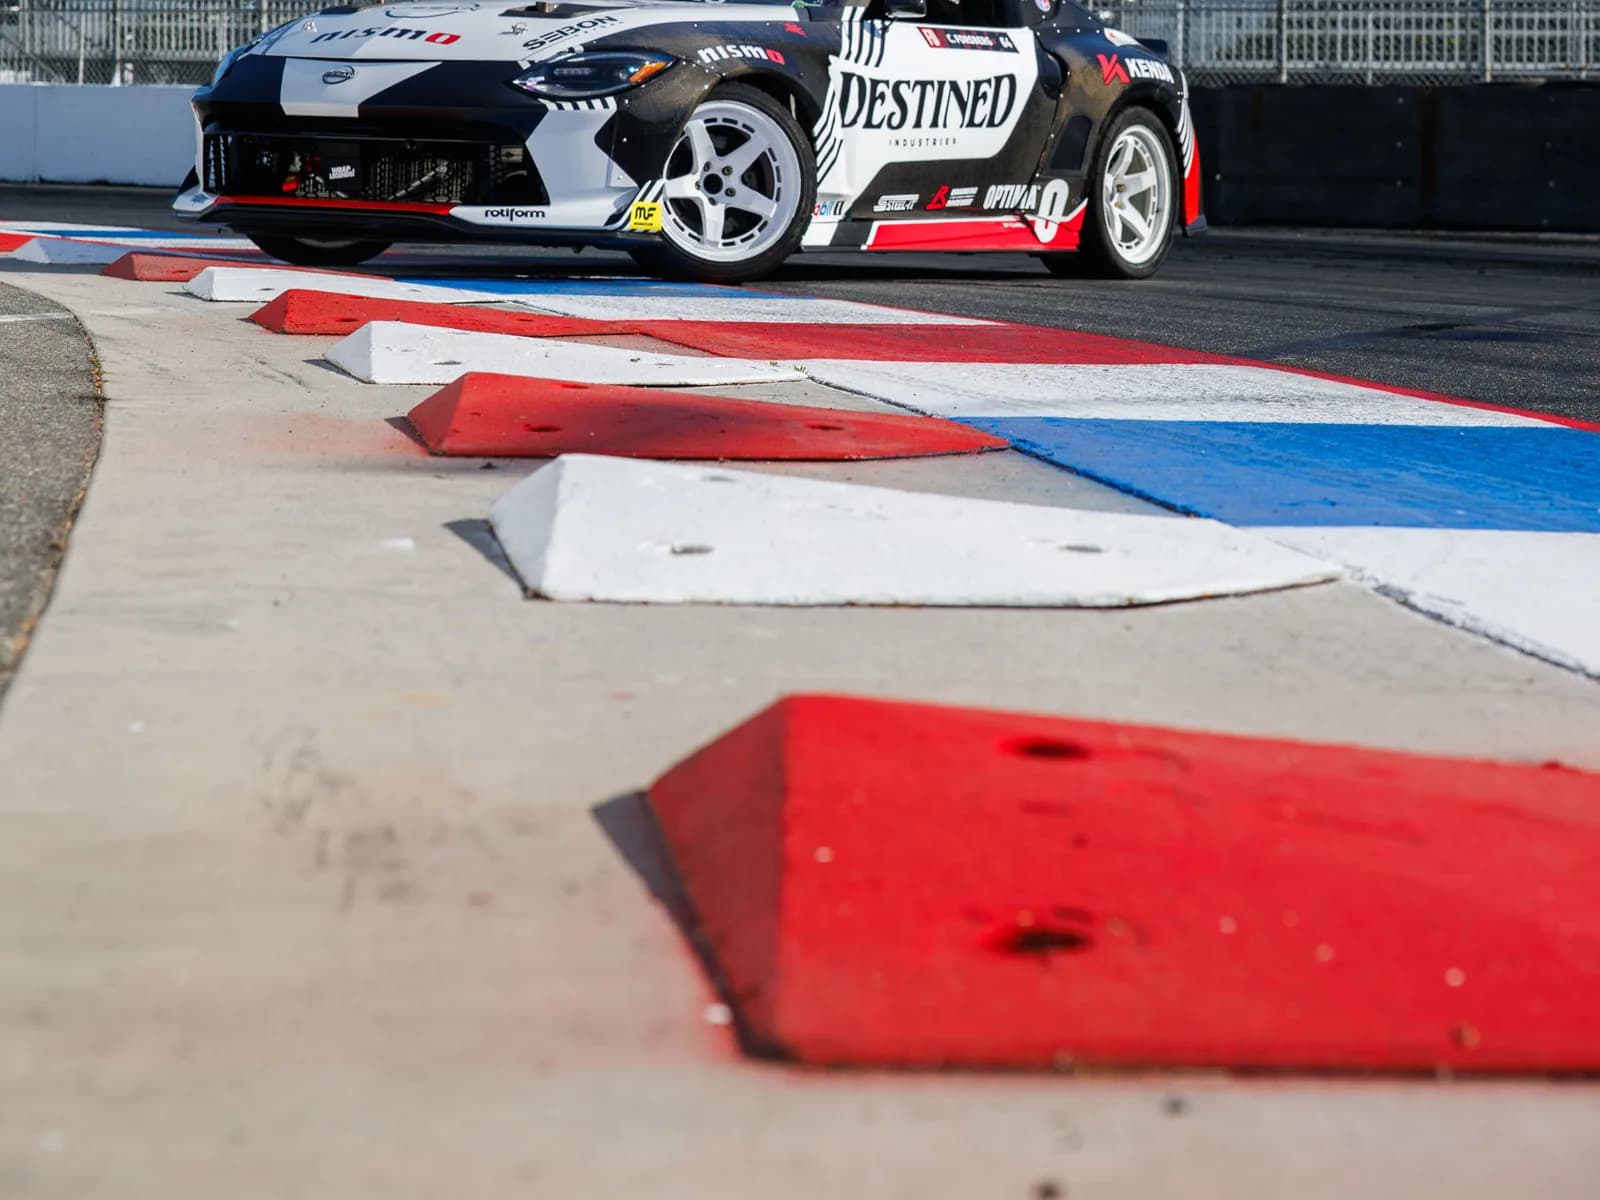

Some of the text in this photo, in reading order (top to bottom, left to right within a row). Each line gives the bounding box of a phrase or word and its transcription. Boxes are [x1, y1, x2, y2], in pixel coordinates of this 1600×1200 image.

[310, 26, 461, 45] nismo
[522, 16, 618, 50] SEBON
[697, 44, 785, 65] nismo
[1124, 58, 1175, 84] KENDA
[839, 71, 1016, 130] DESTINED
[889, 137, 957, 147] INDUSTRIES
[485, 207, 545, 221] rotiform
